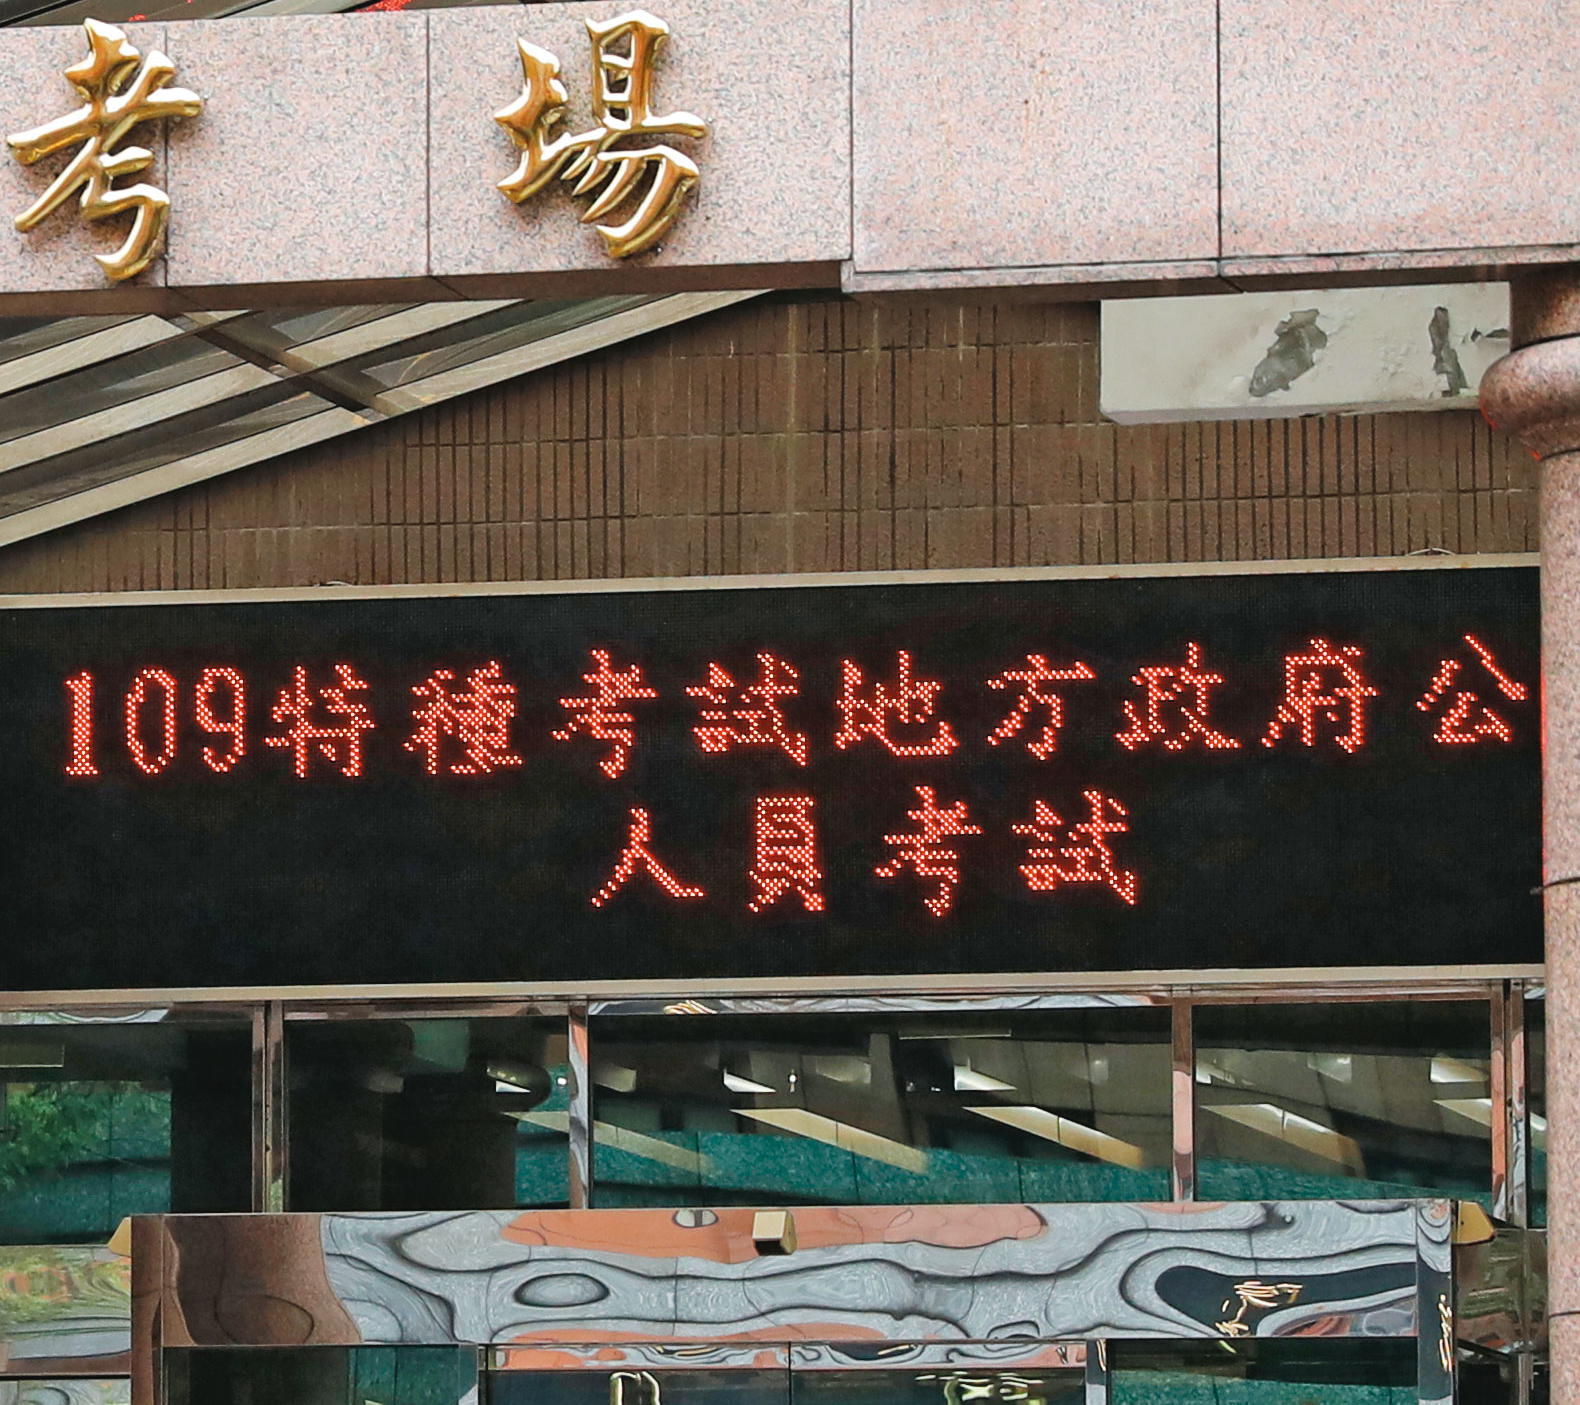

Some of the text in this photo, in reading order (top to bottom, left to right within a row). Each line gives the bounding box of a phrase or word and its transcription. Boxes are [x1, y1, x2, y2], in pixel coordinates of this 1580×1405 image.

[62, 633, 1530, 780] 109特種考試地方政府公
[590, 784, 1139, 917] 人員考試
